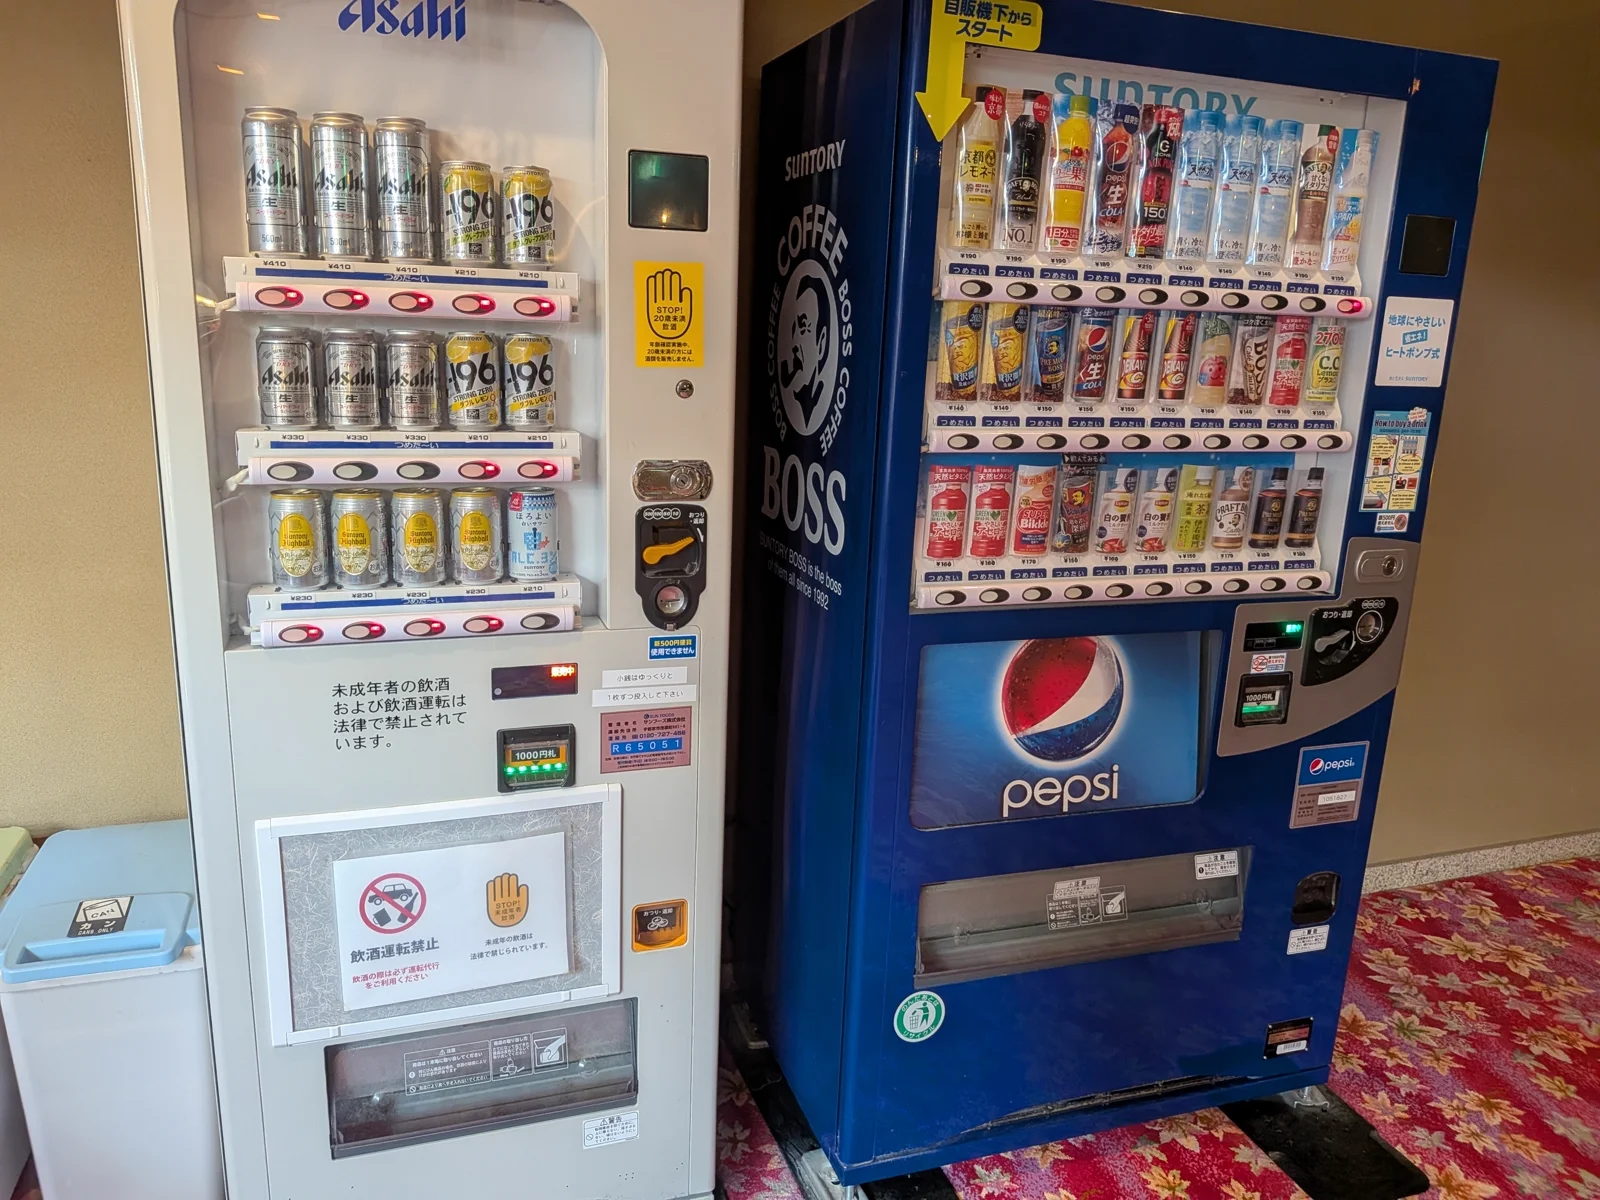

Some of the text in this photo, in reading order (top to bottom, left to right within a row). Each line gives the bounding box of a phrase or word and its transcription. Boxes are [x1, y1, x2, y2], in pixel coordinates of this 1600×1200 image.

[338, 0, 466, 42] Asahi
[957, 19, 1013, 42] スタート
[1054, 72, 1257, 115] SUNTORY
[785, 139, 846, 181] SUNTORY
[262, 197, 278, 208] 生
[331, 201, 347, 211] 生
[393, 205, 408, 215] 生
[777, 204, 848, 277] COFFEE
[953, 266, 986, 275] つめたい
[999, 269, 1031, 278] つめたい
[1044, 272, 1075, 280] つめたい
[1087, 273, 1118, 282] つめたい
[1130, 276, 1160, 284] つめたい
[1171, 278, 1201, 287] つめたい
[1212, 280, 1240, 289] つめたい
[1252, 283, 1279, 291] つめたい
[1290, 285, 1316, 294] つめたい
[1326, 288, 1352, 296] つめたい
[656, 306, 683, 314] STOP!
[654, 315, 686, 323] 20歳未満
[1387, 314, 1446, 327] 地球にやさしい
[662, 323, 677, 331] 飲酒
[767, 282, 781, 376] COFFEE
[1386, 347, 1440, 359] ヒートポンプ式
[820, 279, 853, 456] BOSS COFFEE
[1254, 338, 1268, 396] BOSS
[262, 365, 309, 386] Asahi
[329, 366, 374, 386] Asahi
[390, 367, 434, 387] Asahi
[279, 393, 293, 402] 生
[345, 395, 359, 403] 生
[405, 395, 418, 404] 生
[986, 419, 1016, 427] つめたい
[1153, 420, 1182, 428] つめたい
[761, 445, 846, 556] BOSS
[515, 513, 552, 521] ほろよい
[789, 551, 807, 572] BOSS
[808, 560, 814, 574] is
[815, 563, 824, 584] the
[825, 571, 842, 596] boss
[1137, 566, 1164, 574] つめたい
[928, 574, 960, 582] つめたい
[972, 573, 1002, 581] つめたい
[796, 576, 812, 598] since
[813, 586, 829, 610] 1992
[651, 646, 695, 656] 使用できません
[617, 672, 673, 682] 小銭はゆっくりと
[331, 677, 450, 698] 未成年者の飲酒
[607, 690, 684, 701] 1枚ずつ投入して下さい
[1246, 693, 1273, 702] 1000円札
[333, 694, 467, 715] および飲酒運転は
[333, 711, 467, 734] 法律で禁止されて
[335, 734, 393, 750] います。
[515, 750, 557, 761] 1000円札
[1324, 757, 1353, 771] pepsi
[1002, 764, 1119, 817] pepsi
[495, 900, 521, 909] STOP!
[80, 920, 116, 930] カン
[485, 932, 533, 946] 未成年の飲酒は
[350, 937, 440, 963] 飲酒運転禁止
[470, 943, 548, 960] 法律で禁じられています。
[352, 962, 440, 984] 飲酒の際は必ず運転代行
[365, 973, 429, 989] をご利用ください
